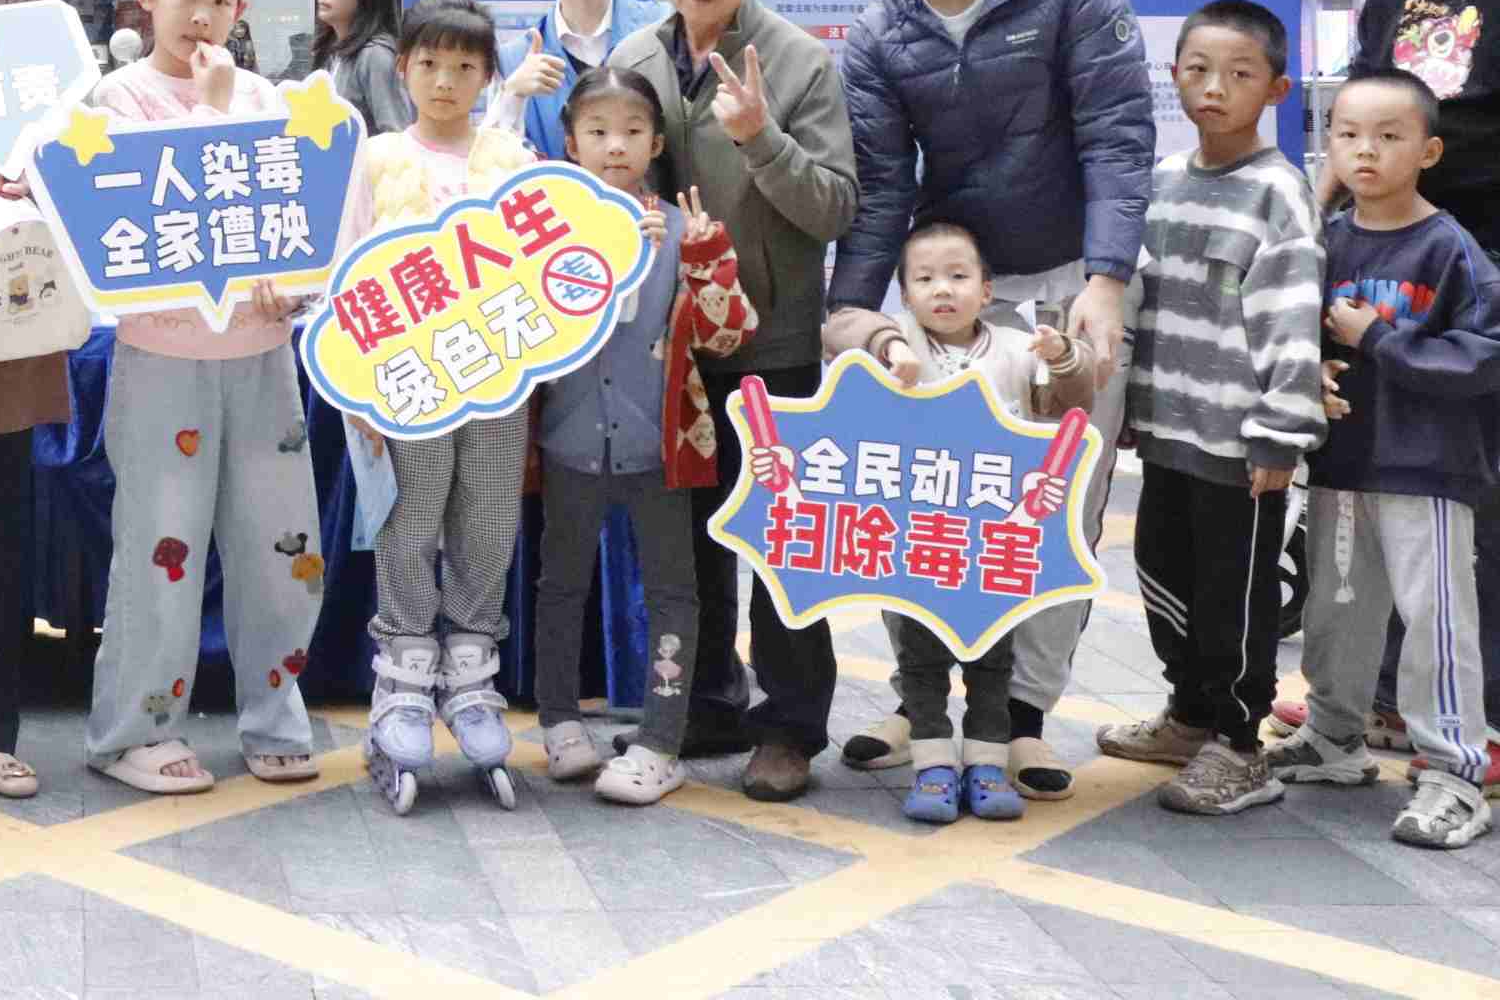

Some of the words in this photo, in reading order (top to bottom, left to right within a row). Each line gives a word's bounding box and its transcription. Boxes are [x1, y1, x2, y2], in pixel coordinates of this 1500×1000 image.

[94, 135, 302, 207] 一人染毒
[100, 200, 315, 278] 全家遭殃
[331, 187, 572, 354] 健康人生
[801, 437, 1015, 512] 全民动员
[764, 496, 1043, 598] 扫除毒害
